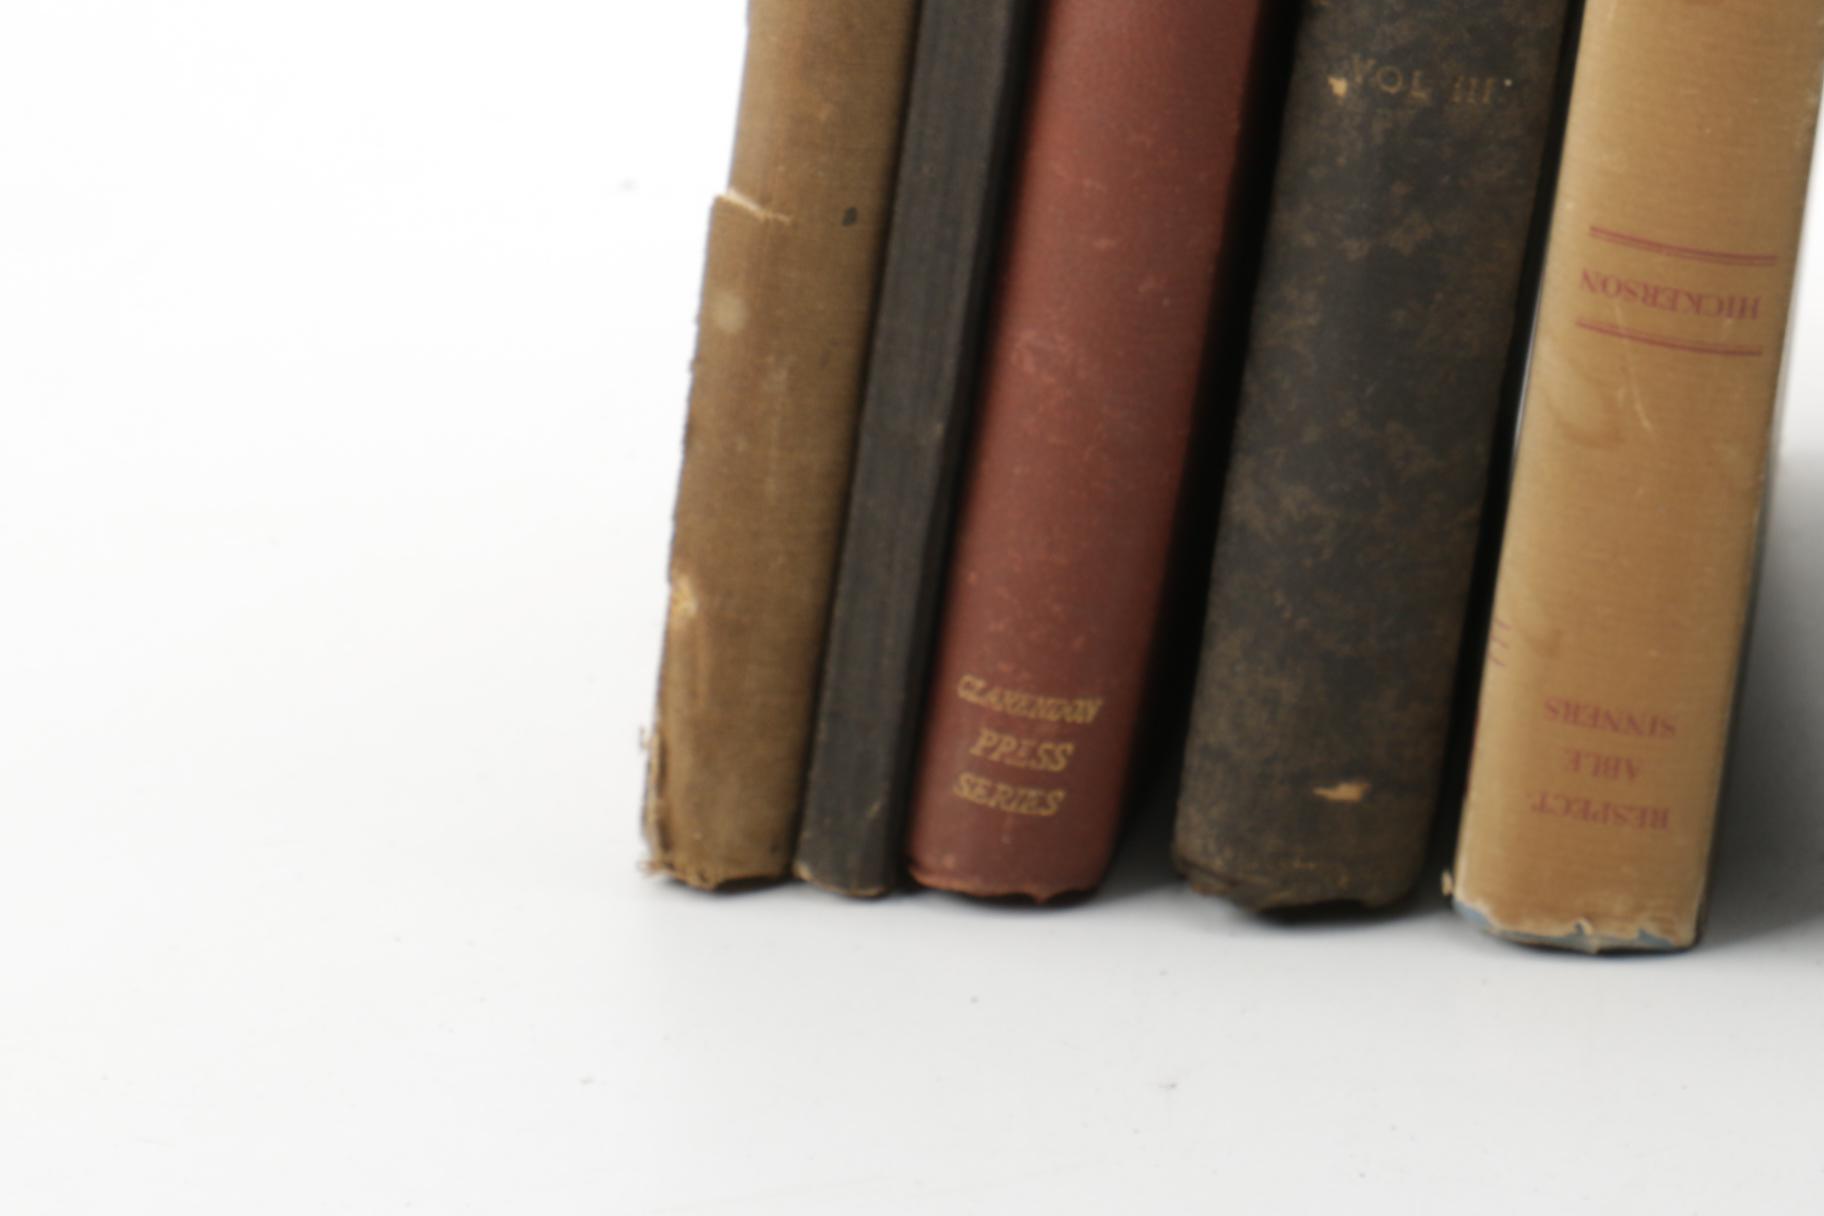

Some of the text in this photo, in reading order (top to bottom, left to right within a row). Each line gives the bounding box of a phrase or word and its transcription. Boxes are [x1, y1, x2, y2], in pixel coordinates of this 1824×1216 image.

[1580, 268, 1763, 321] HICKERSON
[1543, 697, 1678, 739] SINNERS
[969, 728, 1076, 772] PRESS
[1563, 750, 1640, 783] ABLE
[952, 771, 1065, 817] SERIES
